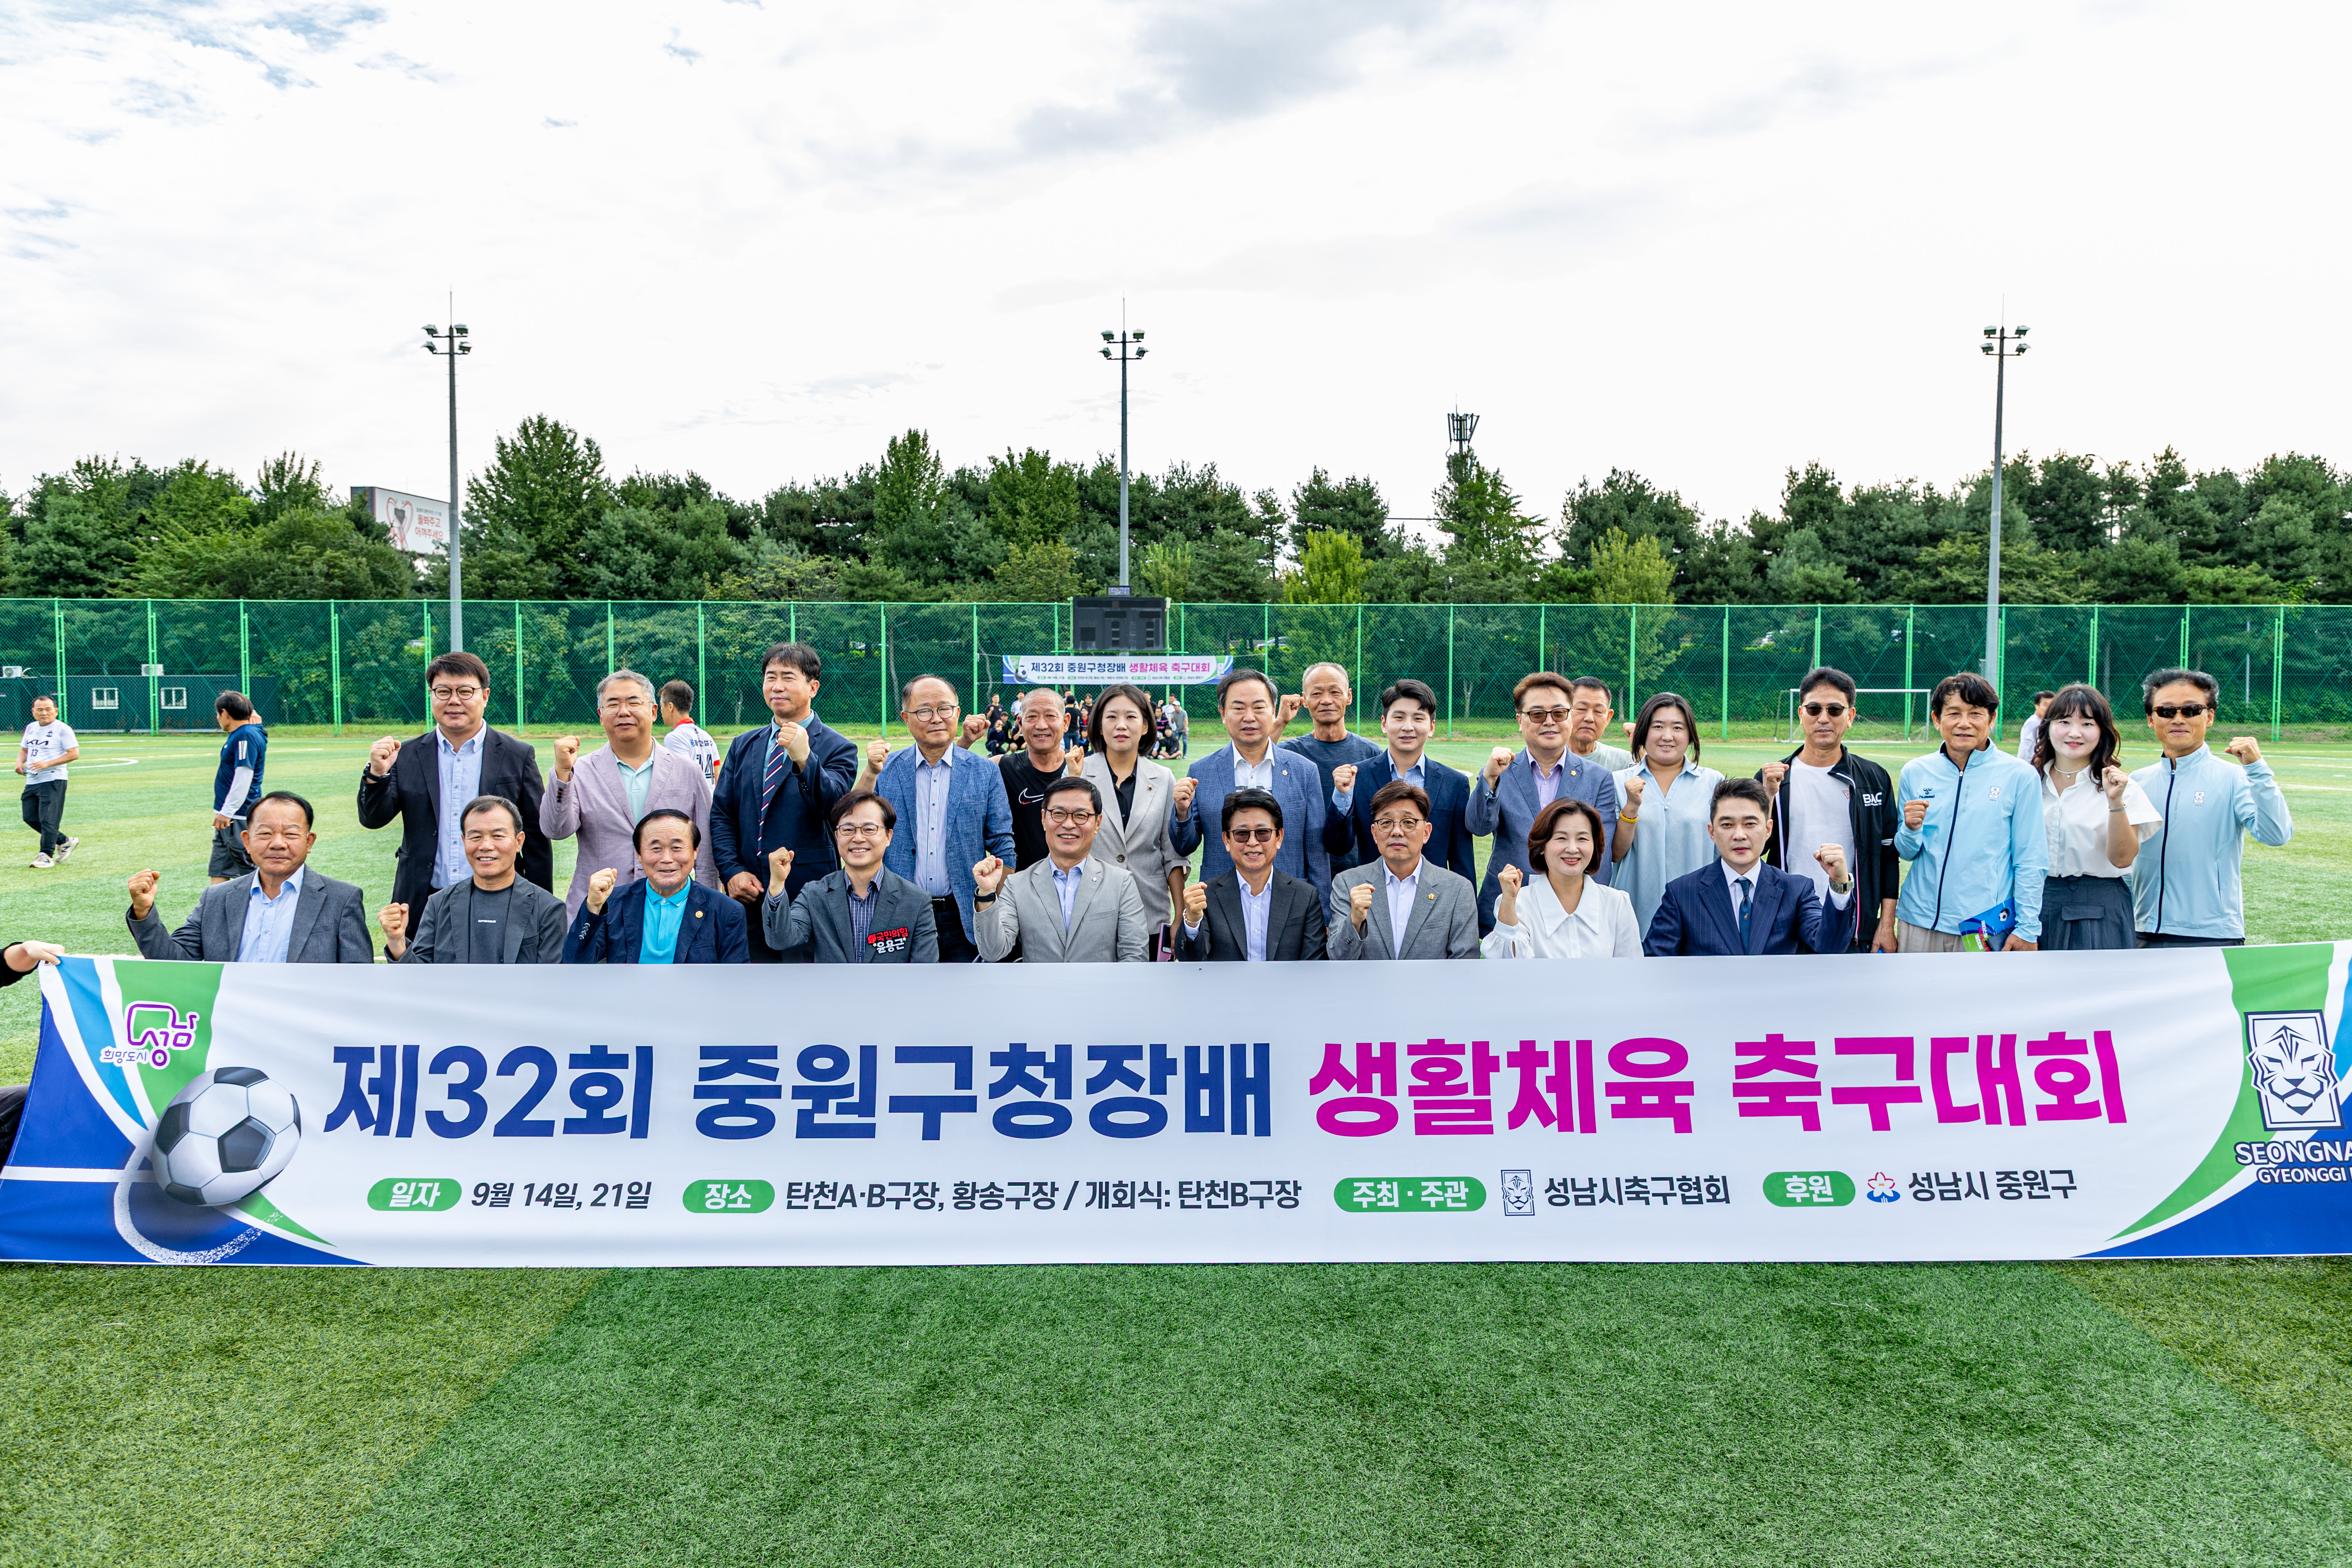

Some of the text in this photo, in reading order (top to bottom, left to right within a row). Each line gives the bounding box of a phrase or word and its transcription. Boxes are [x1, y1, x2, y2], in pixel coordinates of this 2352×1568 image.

[1031, 662, 1210, 673] 제32회 중원구청장배 생활체육 축구대회
[1862, 792, 1882, 804] BAC
[876, 927, 908, 942] 국민의힘
[877, 938, 904, 954] 윤용근
[103, 1049, 147, 1063] 희망도시
[323, 1030, 2127, 1141] 제32회 중원구청장배 생활체육 축구대회
[2258, 1167, 2347, 1183] GYEONGGI
[1544, 1175, 1730, 1207] 성남시축구협회
[1784, 1170, 2077, 1202] 후원 성남시 중원구
[389, 1181, 652, 1210] 일자 9월 14일, 21일
[704, 1180, 1302, 1212] 장소 탄천A·B구장, 황송구장 / 개회식: 탄천B구장
